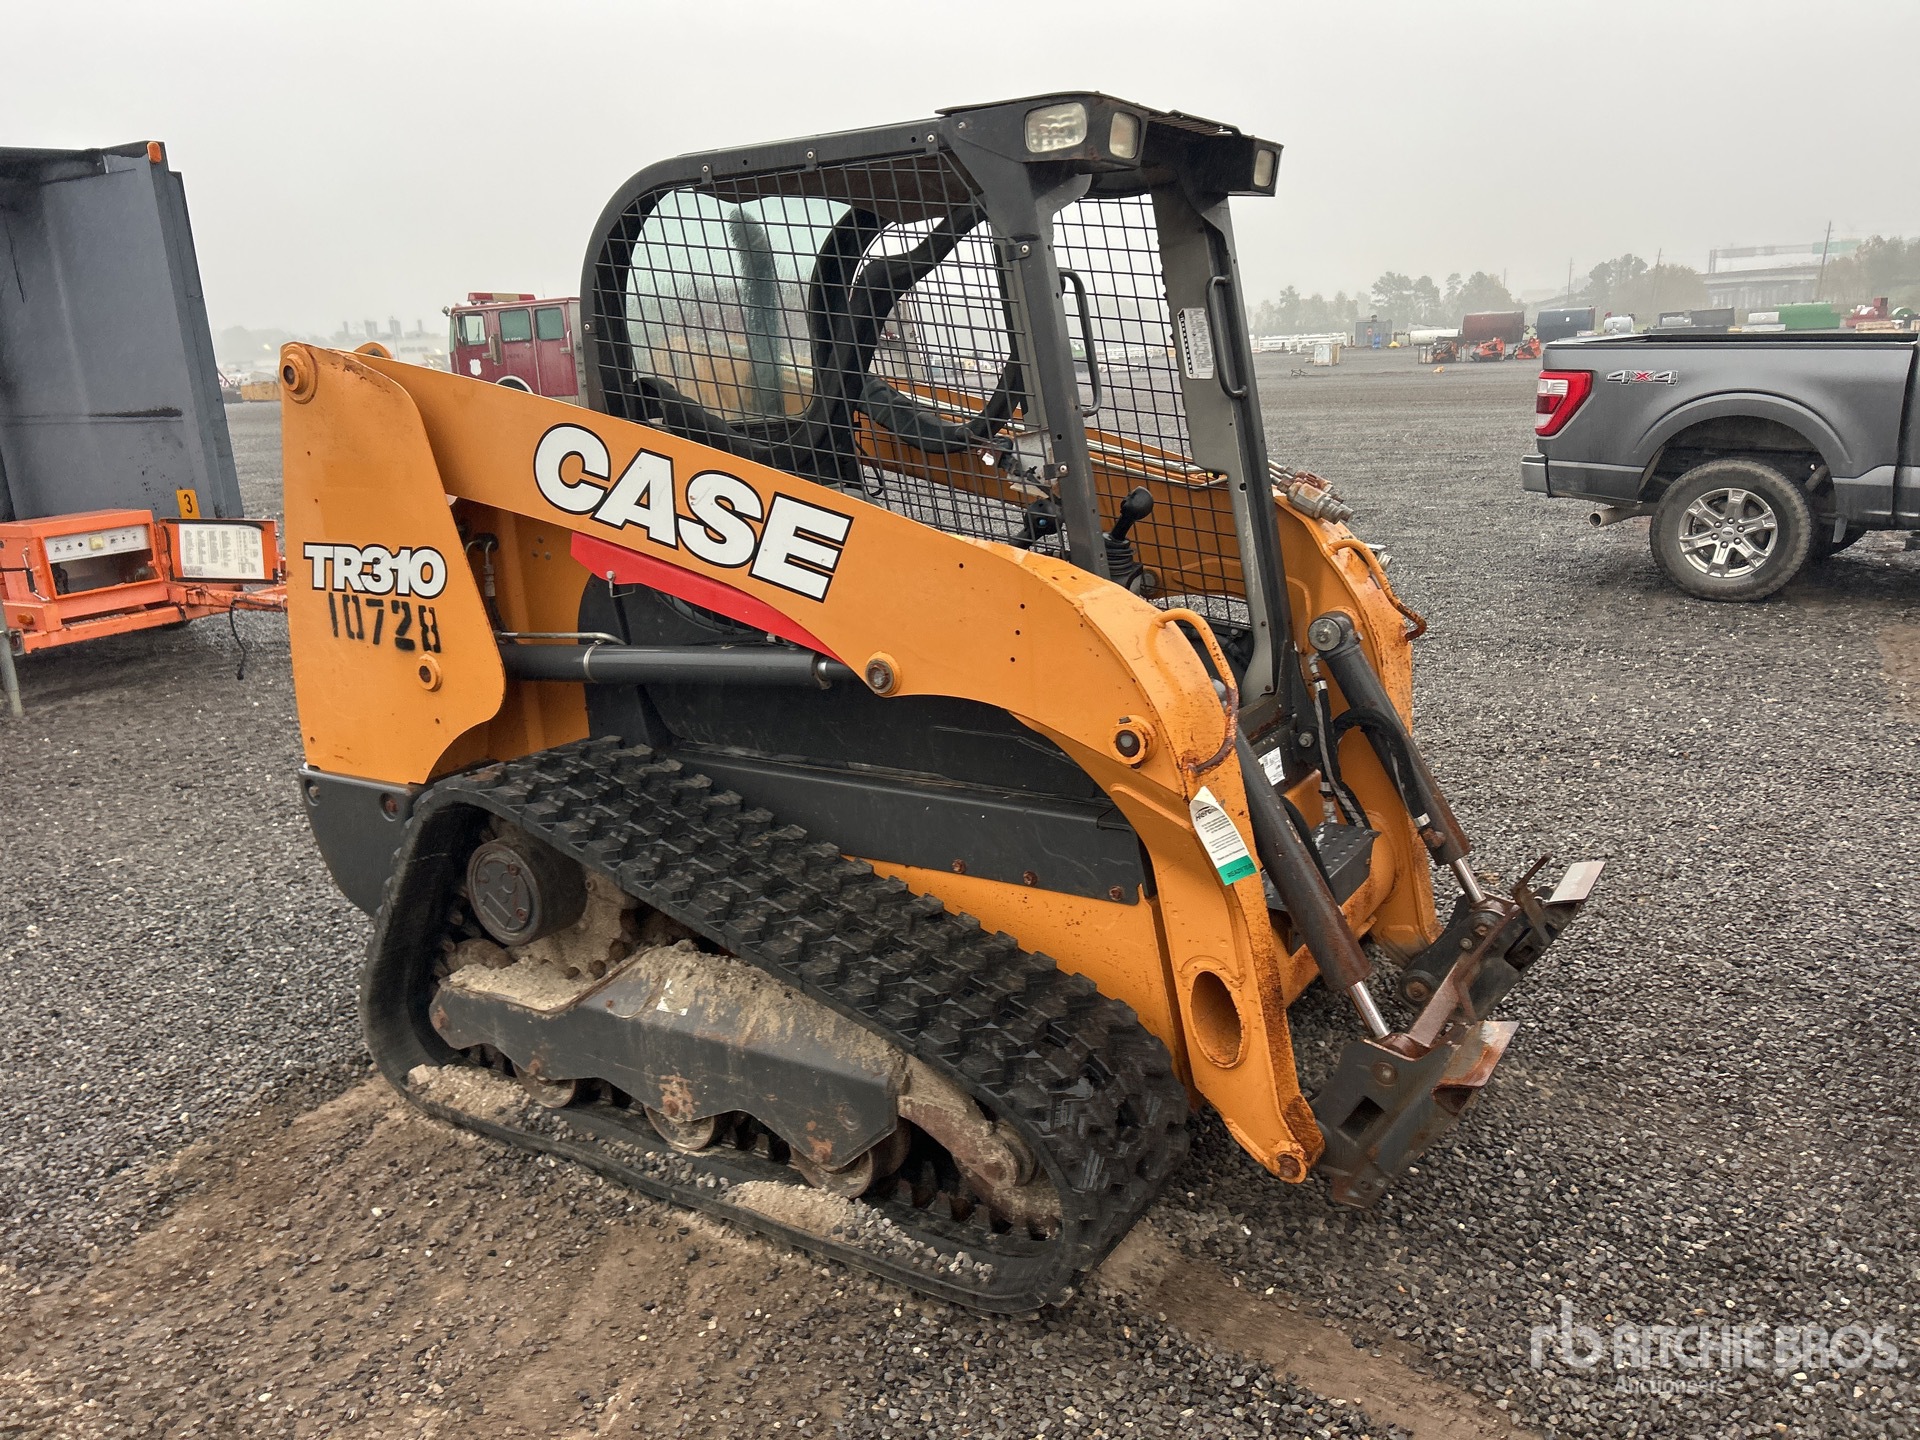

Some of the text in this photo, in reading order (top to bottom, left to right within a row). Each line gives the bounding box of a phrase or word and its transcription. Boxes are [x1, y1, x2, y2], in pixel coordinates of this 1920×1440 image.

[183, 493, 193, 514] 3
[533, 422, 854, 603] CASE
[303, 541, 448, 599] TR310
[328, 592, 442, 653] 10728
